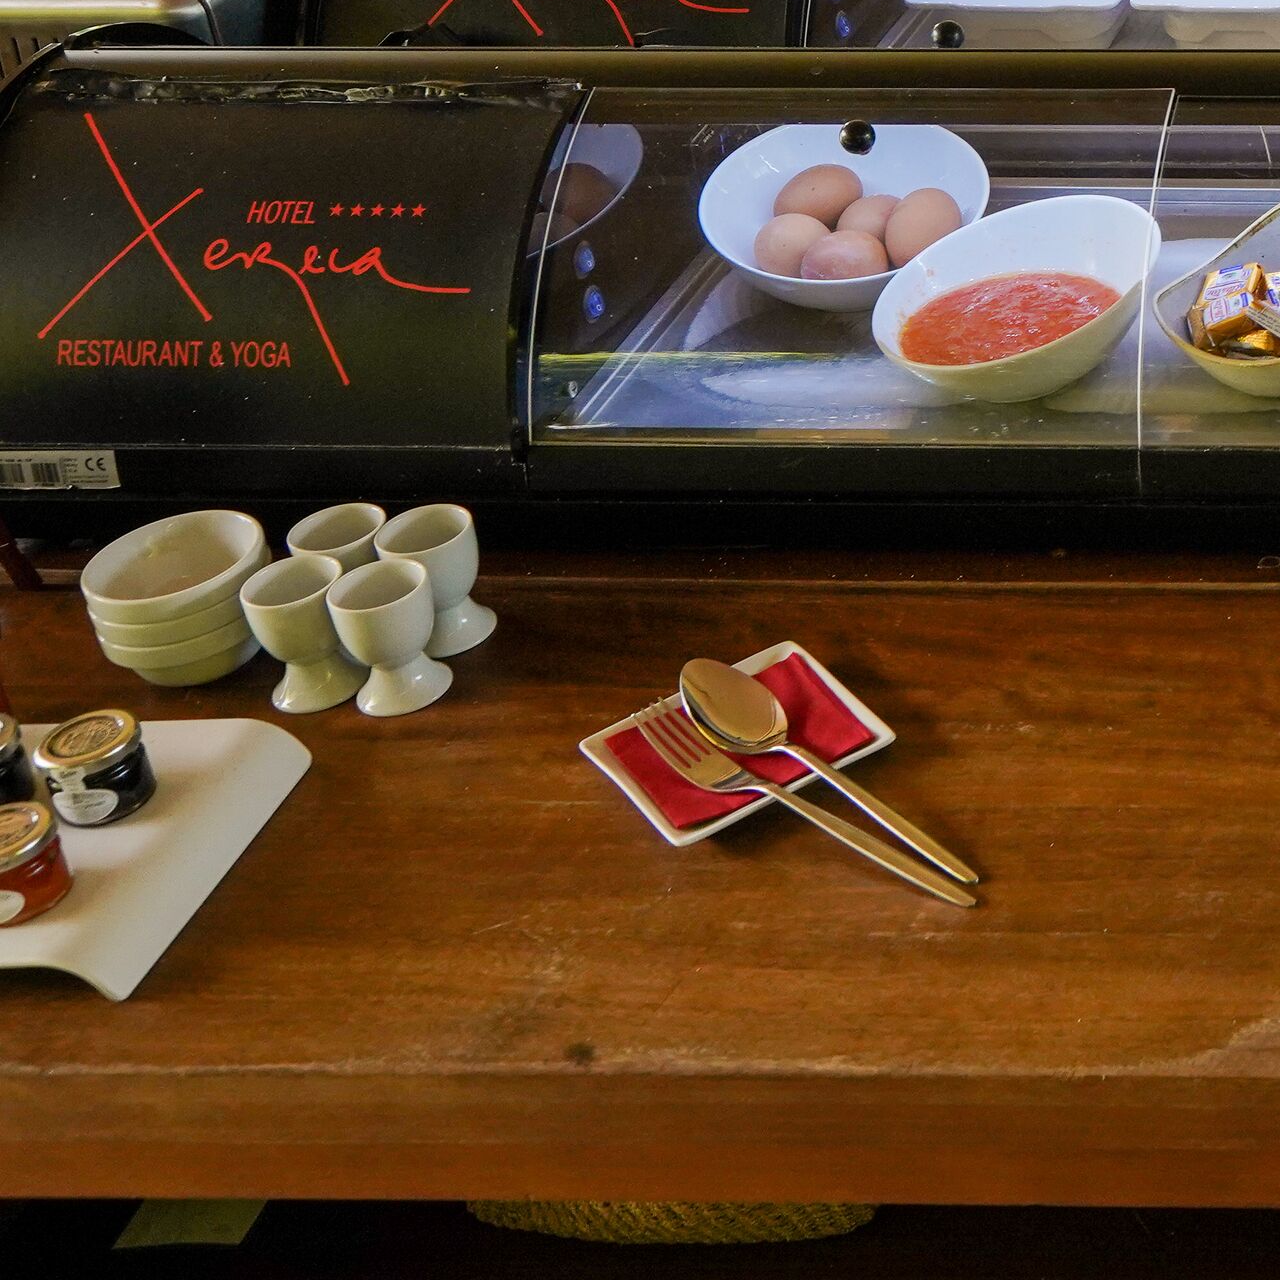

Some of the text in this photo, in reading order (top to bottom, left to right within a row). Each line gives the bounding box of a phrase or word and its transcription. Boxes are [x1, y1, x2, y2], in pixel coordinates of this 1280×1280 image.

[246, 200, 315, 225] HOTEL
[57, 339, 291, 368] RESTAURANT & YOGA
